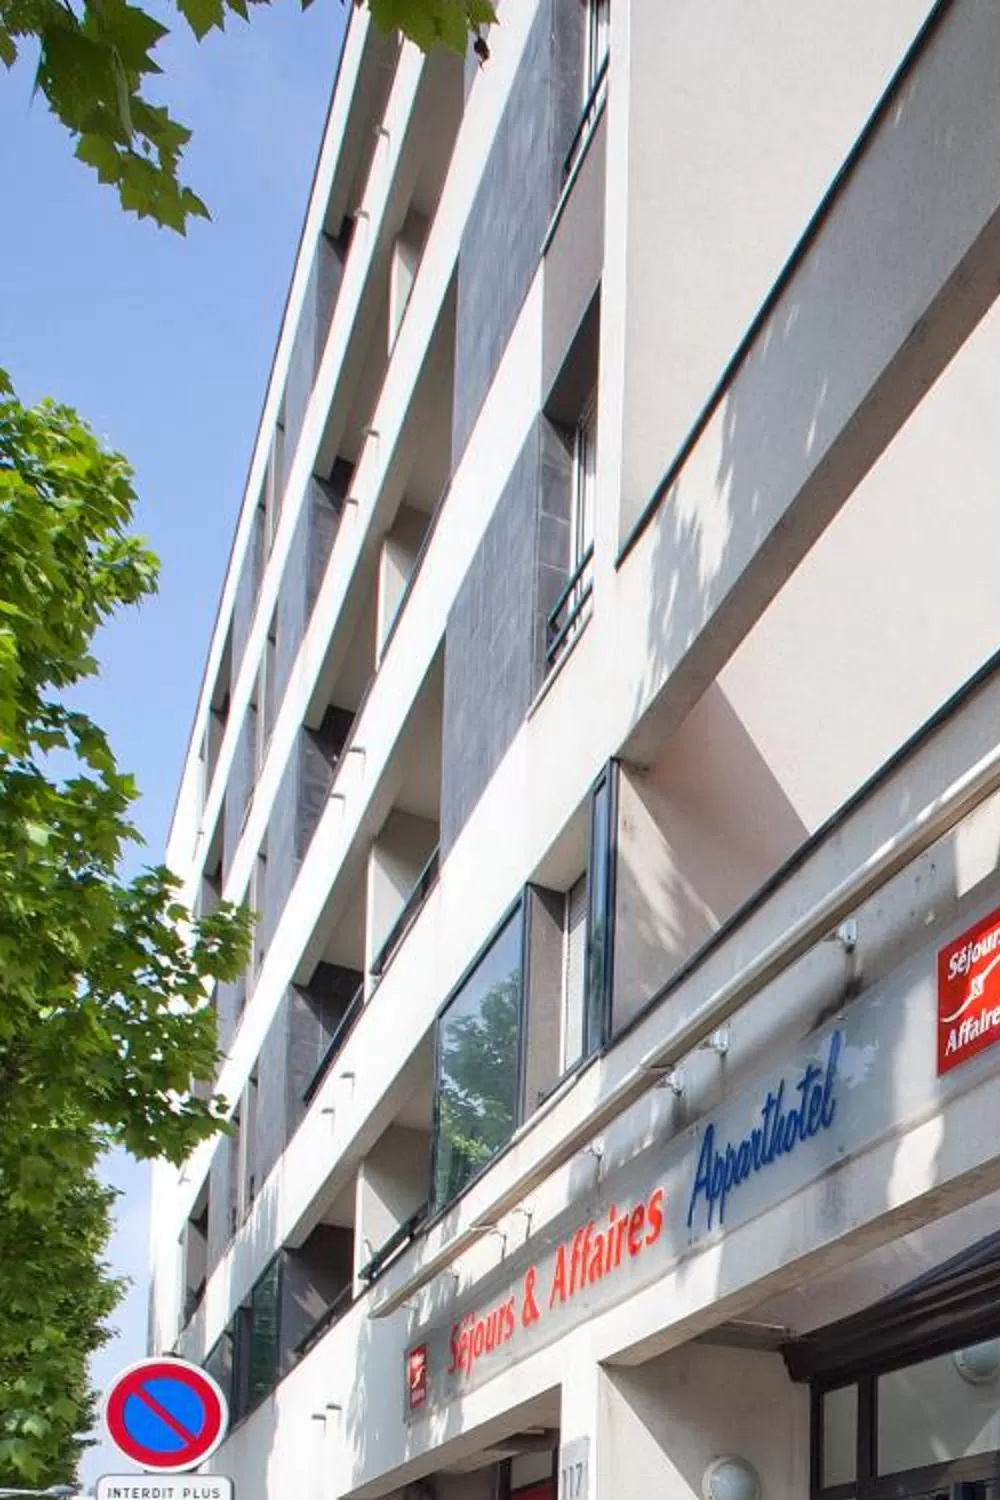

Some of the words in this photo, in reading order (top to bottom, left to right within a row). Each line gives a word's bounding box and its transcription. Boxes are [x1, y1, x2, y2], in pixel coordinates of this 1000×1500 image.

[687, 1029, 842, 1232] Apparthotel
[447, 1294, 516, 1377] Séjours
[521, 1264, 541, 1329] &
[549, 1187, 666, 1310] Affaires
[107, 1487, 175, 1499] INTERDIT
[183, 1487, 222, 1499] PLUS
